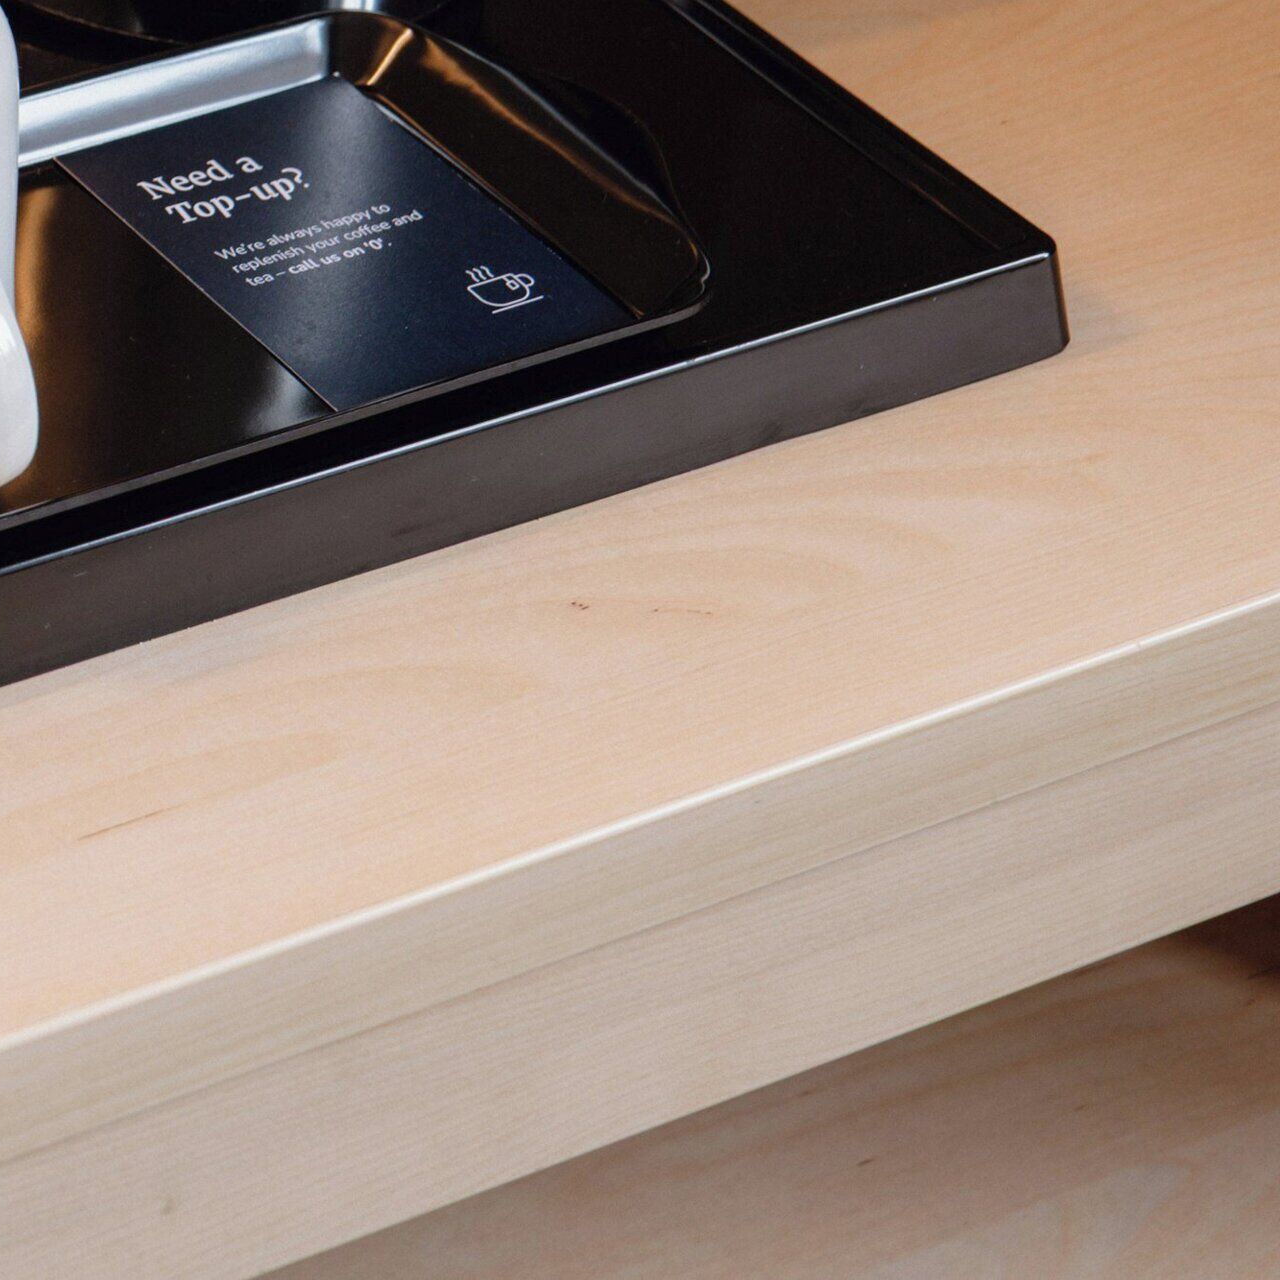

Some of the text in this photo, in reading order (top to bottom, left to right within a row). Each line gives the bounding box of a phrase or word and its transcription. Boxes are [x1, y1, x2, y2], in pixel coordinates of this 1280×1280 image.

[136, 156, 264, 201] Need a
[164, 167, 310, 224] Top-up?
[213, 204, 391, 260] We're always happy to
[231, 209, 424, 274] replenish your coffee and
[245, 273, 275, 287] tea
[288, 258, 321, 274] call
[319, 253, 342, 265] us
[342, 245, 365, 259] on
